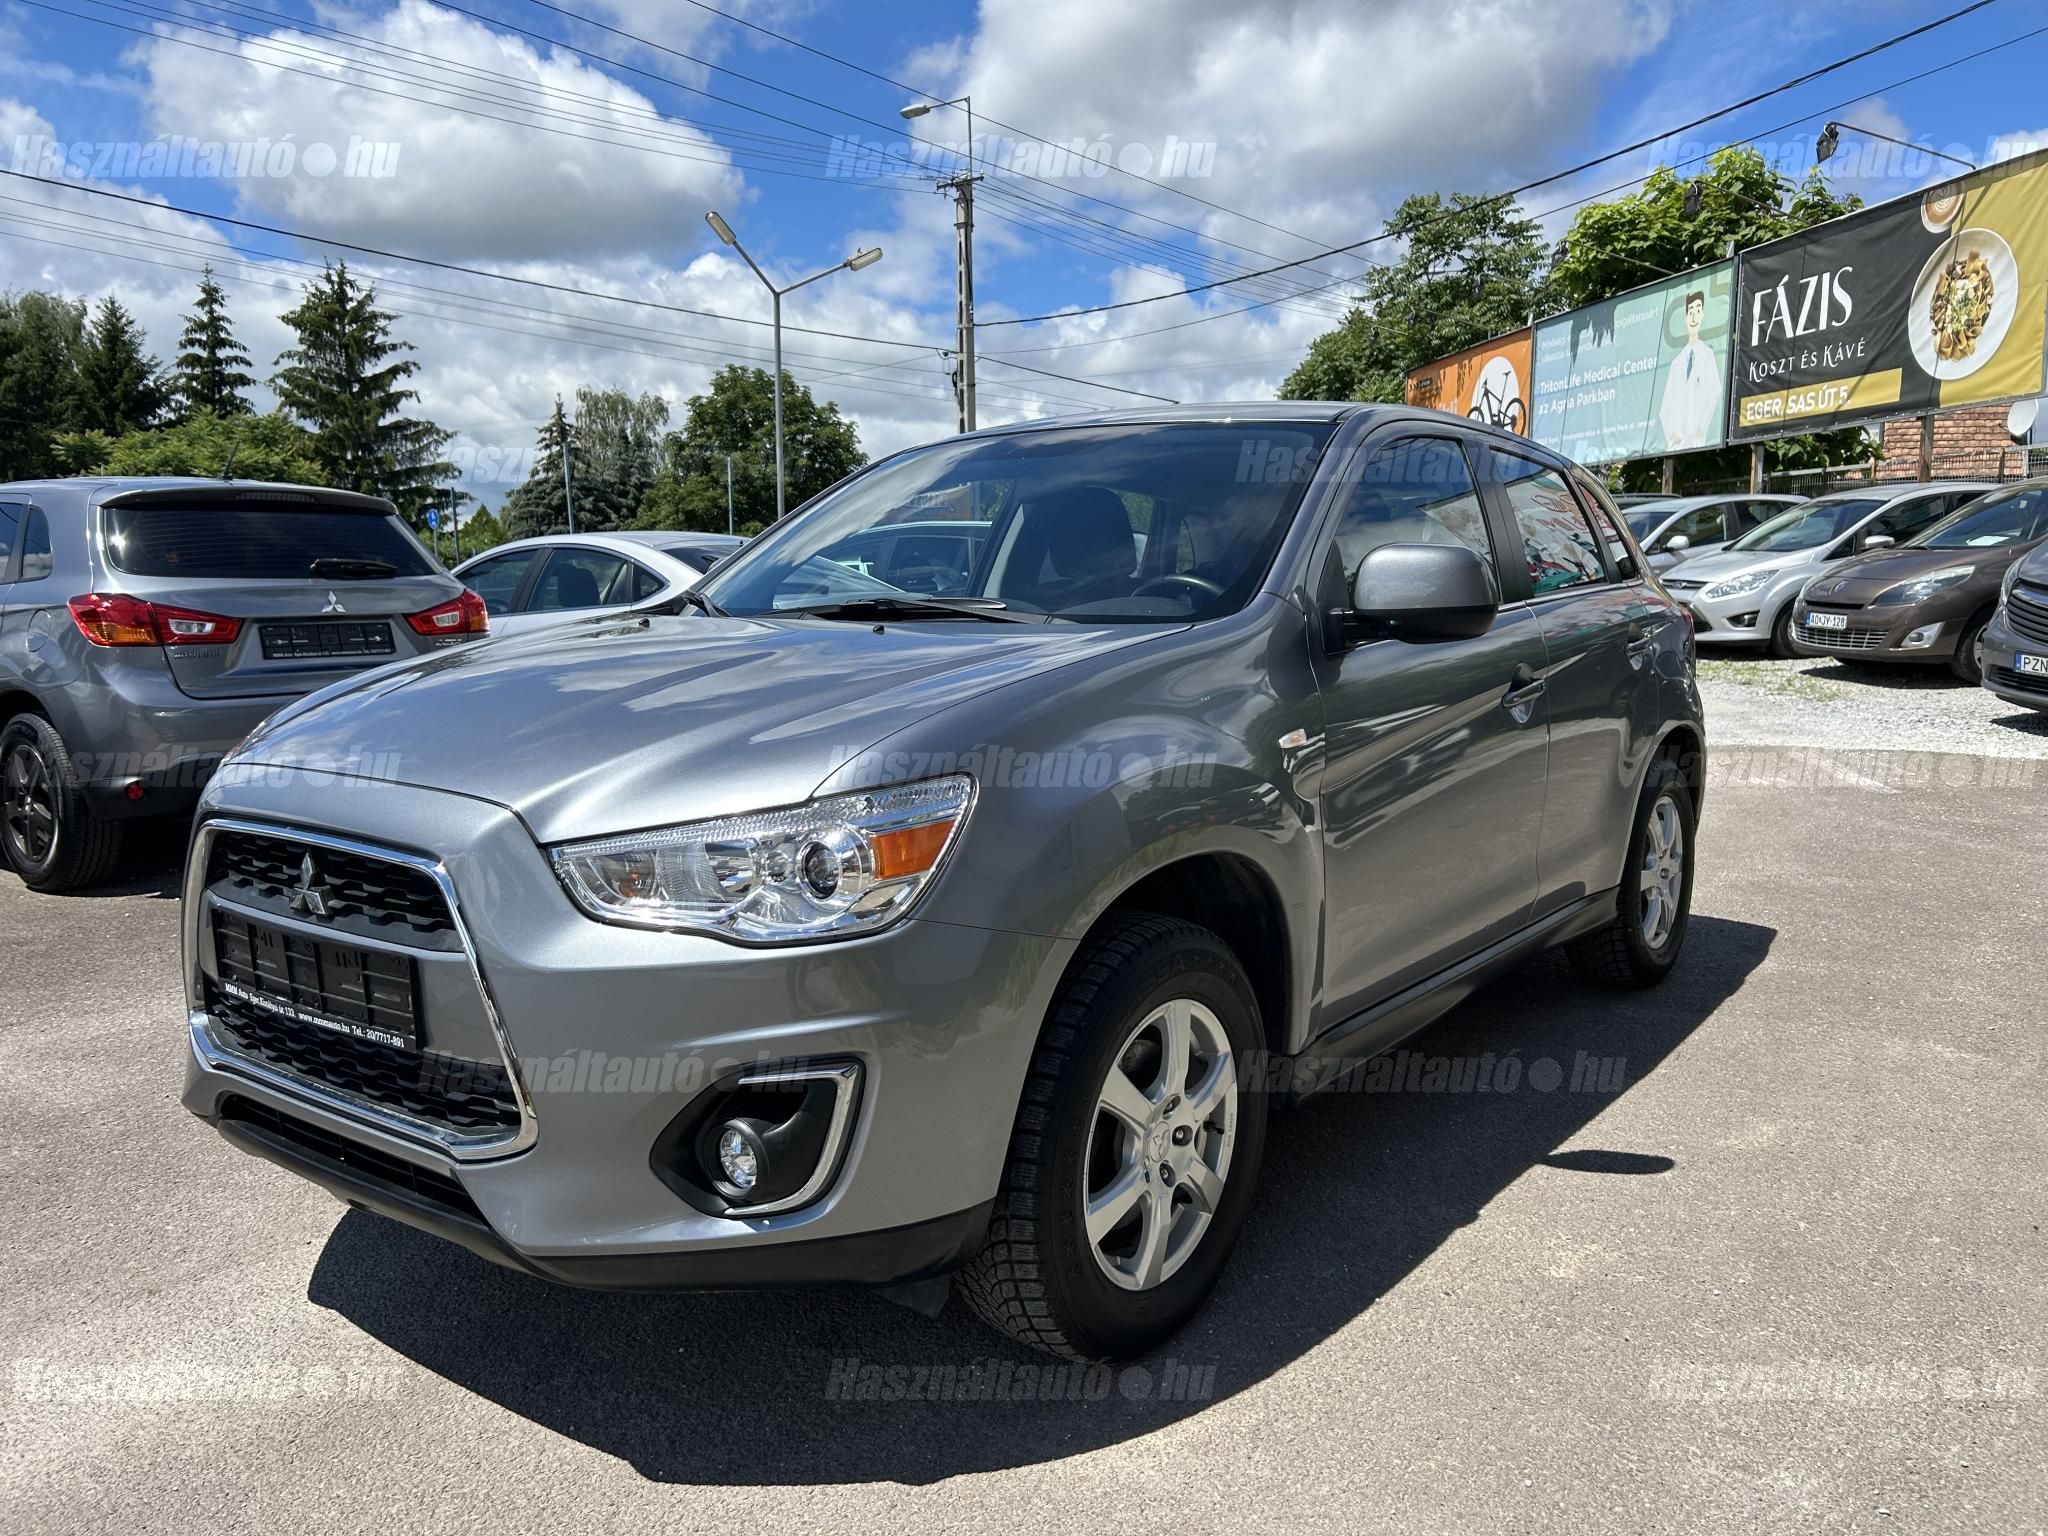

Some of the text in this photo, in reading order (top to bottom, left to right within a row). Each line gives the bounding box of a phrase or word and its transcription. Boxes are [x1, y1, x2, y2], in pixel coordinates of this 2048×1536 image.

[1751, 266, 1853, 347] FÁZIS
[1540, 356, 1658, 395] TritonLife Medical Center
[1749, 337, 1866, 383] KOSZT ÉS KÁVÉ
[1538, 403, 1548, 416] az
[1576, 387, 1616, 407] Parkban
[1746, 398, 1784, 421] EGER,
[1785, 391, 1816, 414] SAS
[1818, 384, 1838, 409] ÚT
